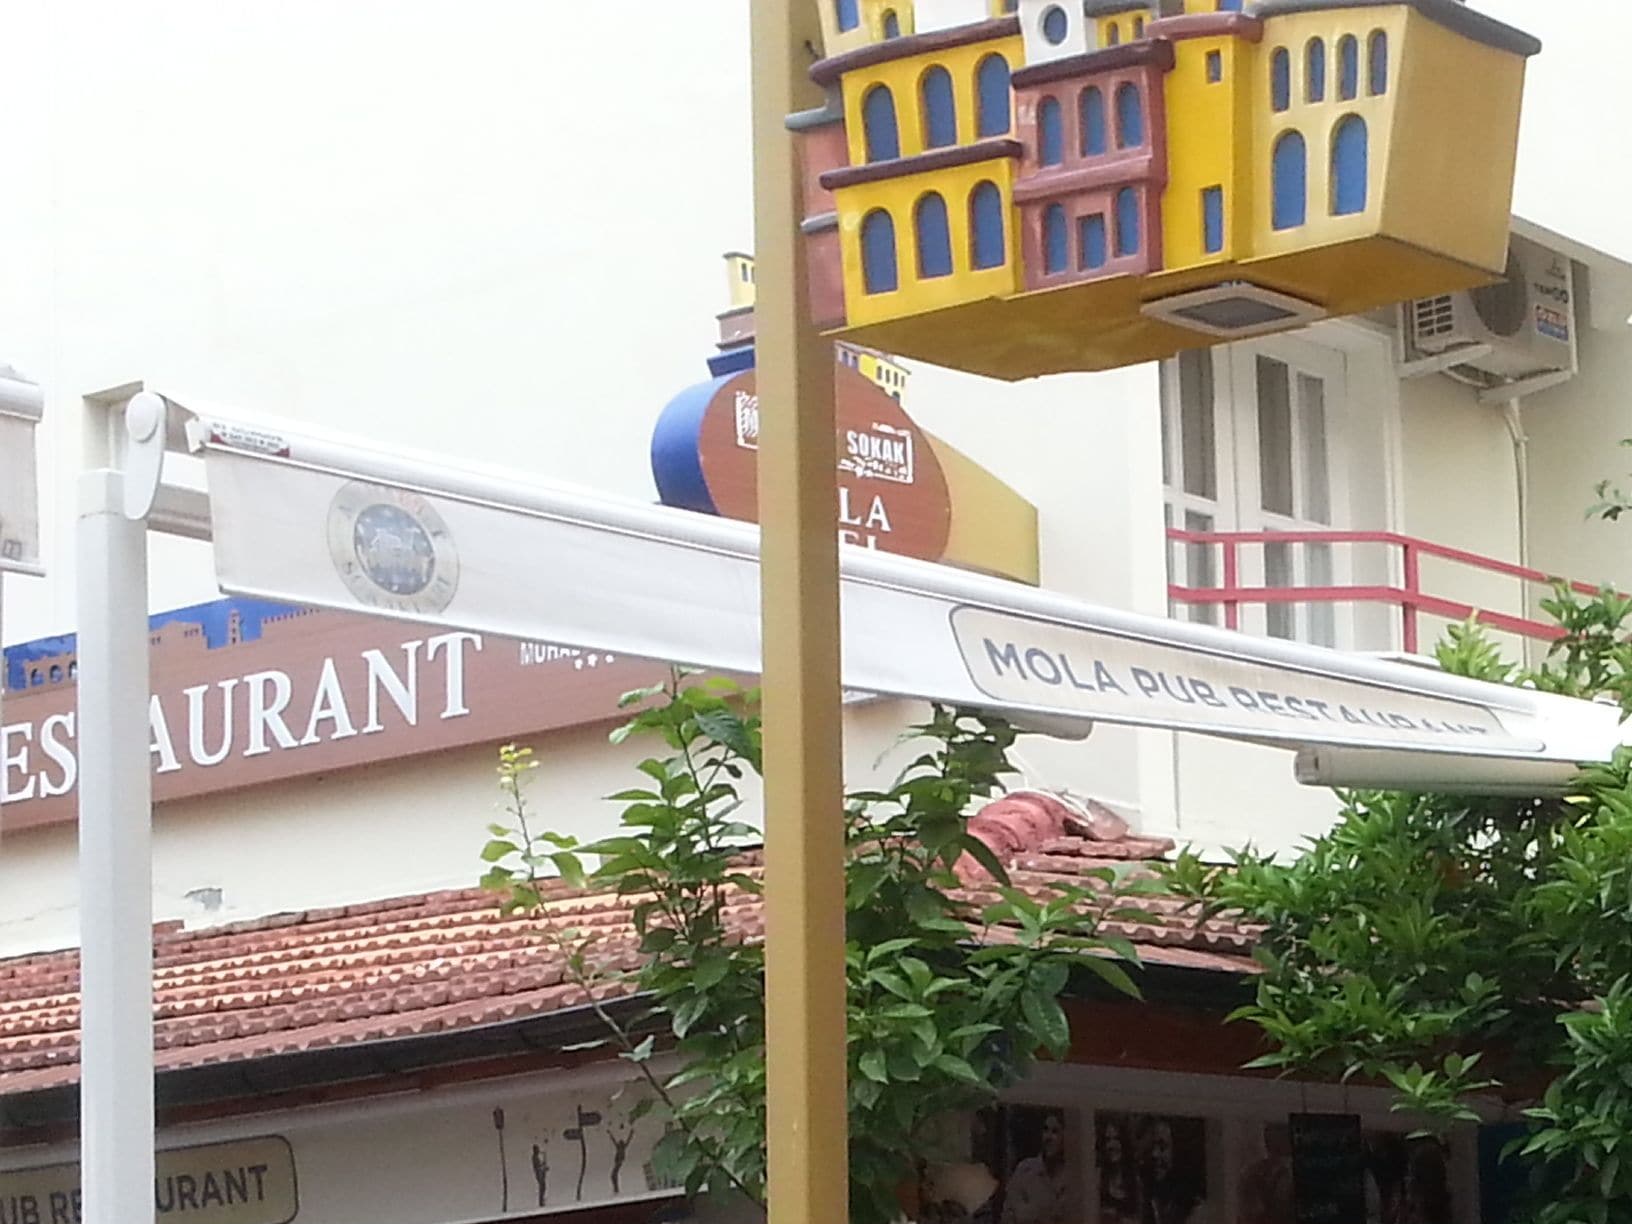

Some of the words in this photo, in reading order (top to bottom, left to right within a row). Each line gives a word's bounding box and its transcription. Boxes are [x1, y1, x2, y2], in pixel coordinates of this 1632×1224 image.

[847, 430, 904, 464] SOKAK
[839, 486, 891, 532] LA
[983, 638, 1127, 696] MOLA
[1131, 667, 1227, 708] PUB
[0, 631, 484, 802] ESAURANT
